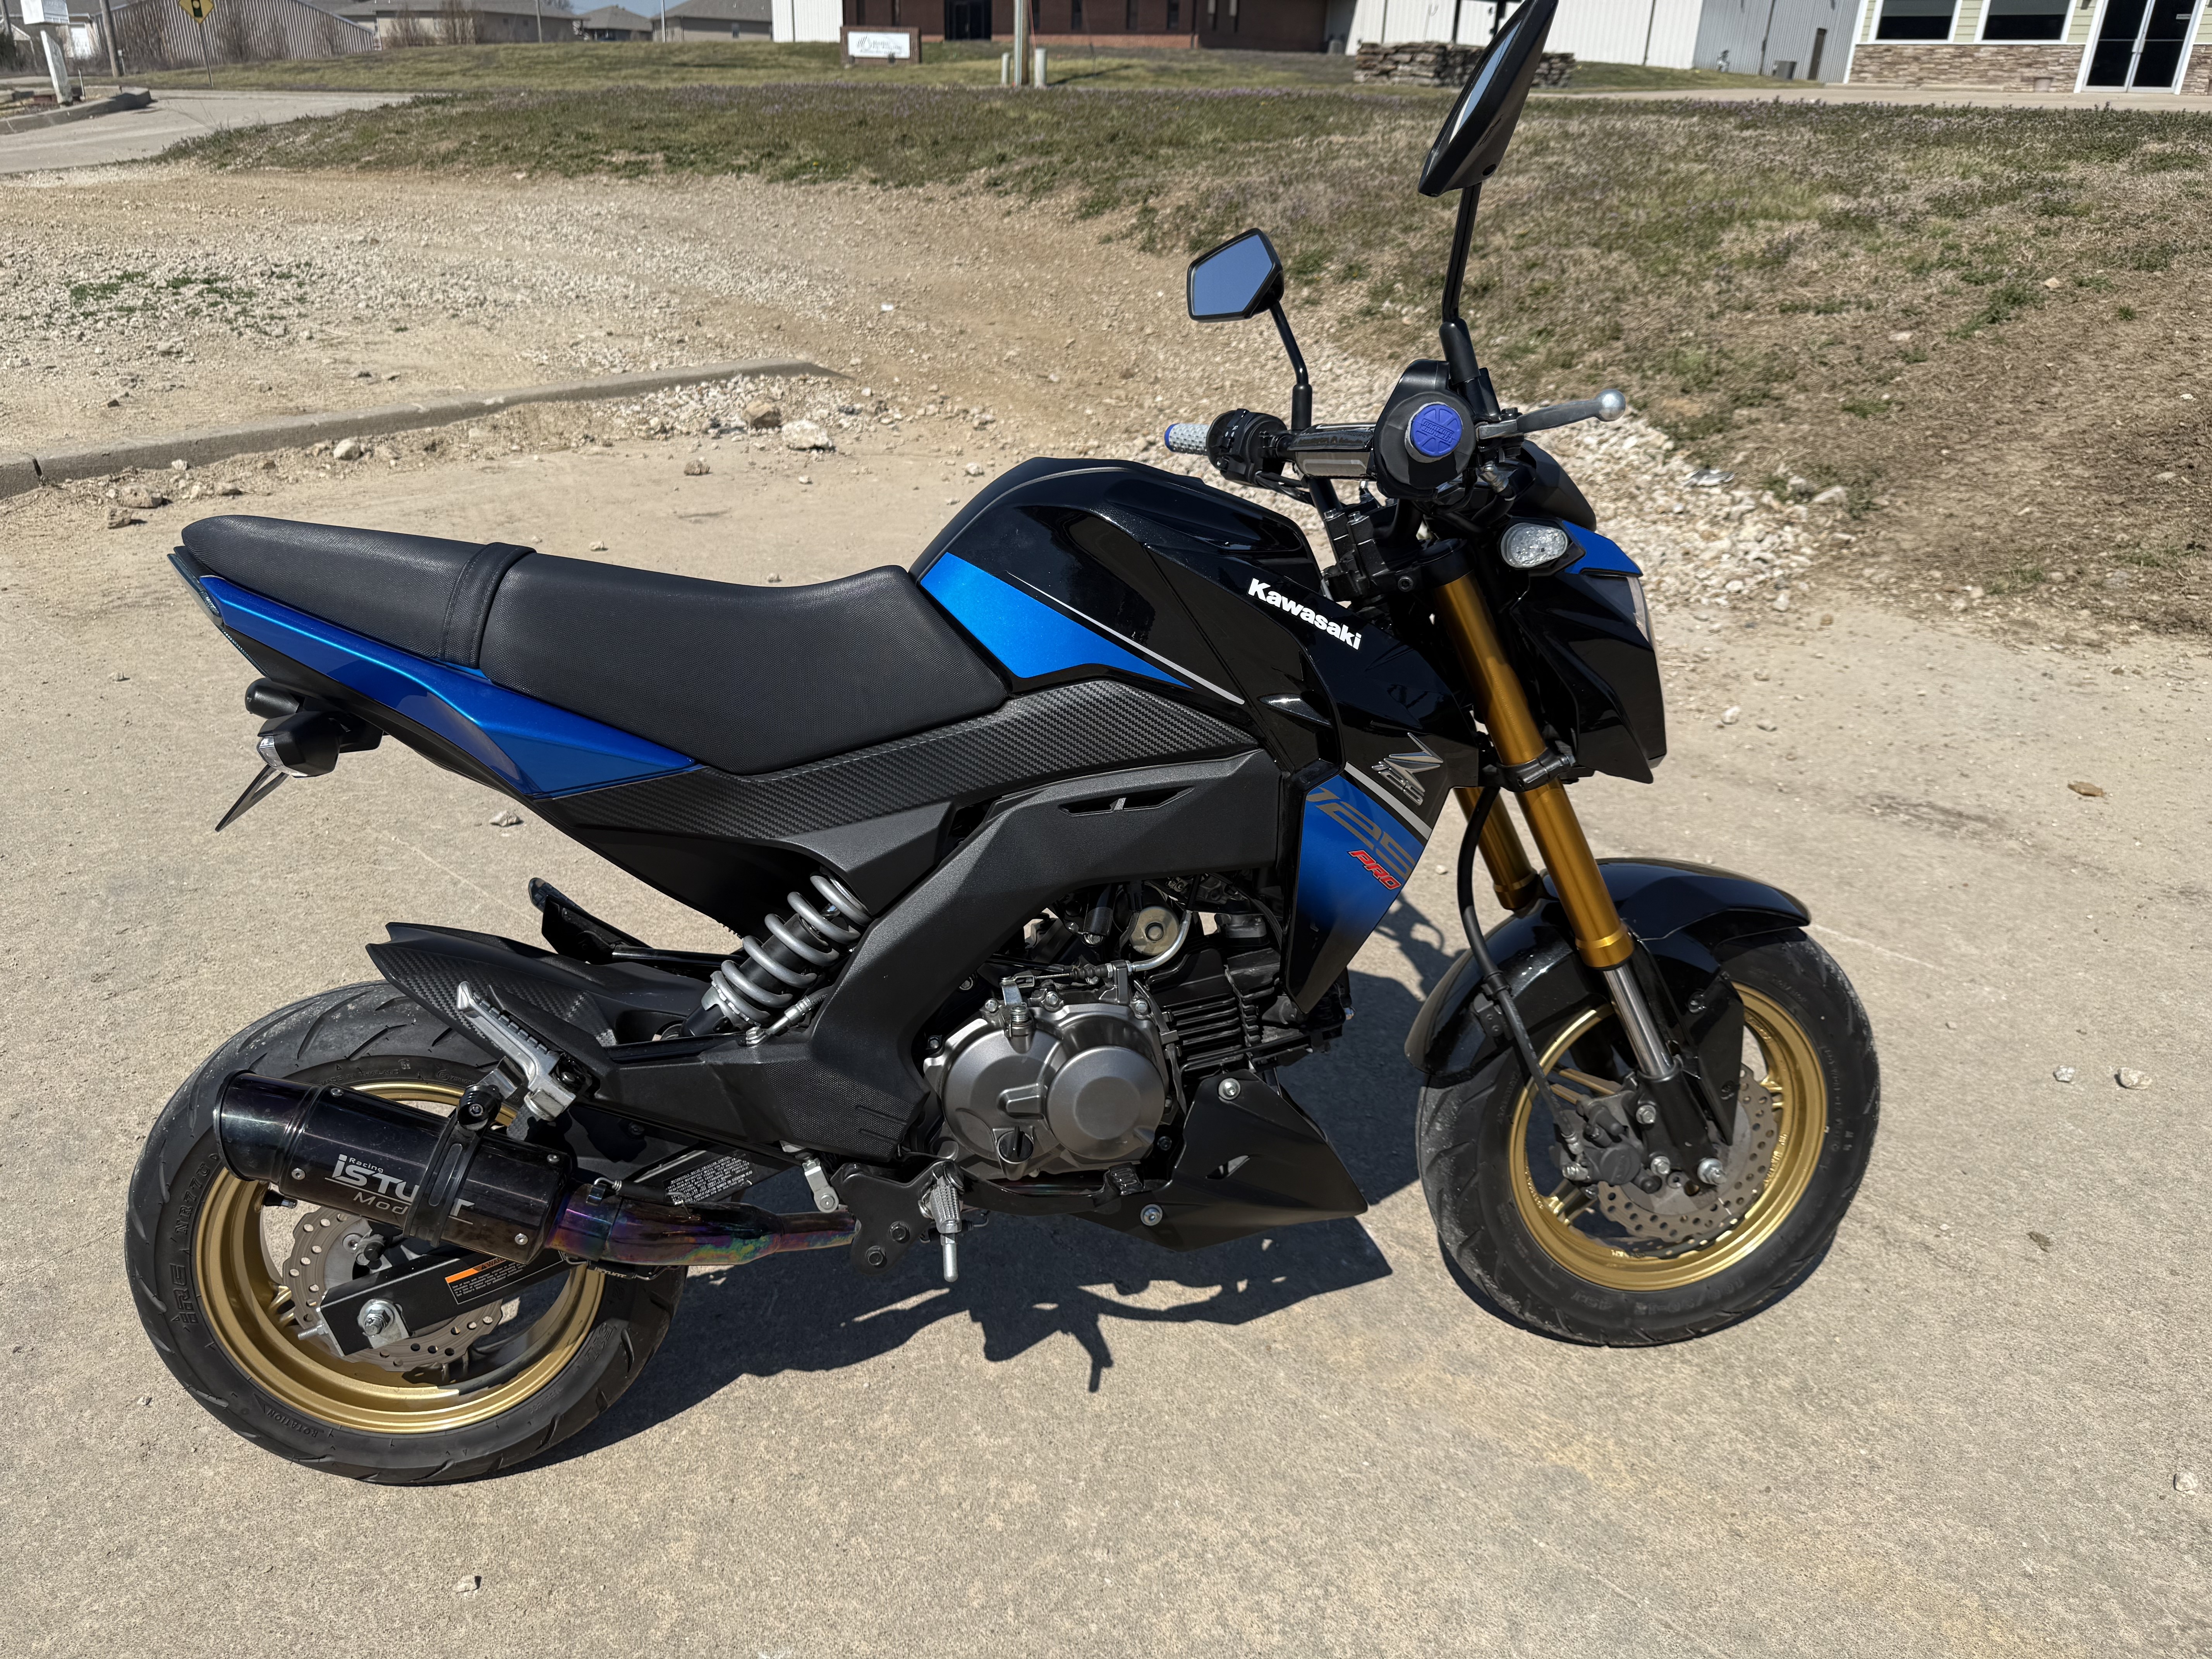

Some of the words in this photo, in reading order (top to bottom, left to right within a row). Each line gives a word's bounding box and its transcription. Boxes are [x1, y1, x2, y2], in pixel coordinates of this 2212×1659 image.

[1248, 578, 1362, 650] Kawasaki
[1307, 786, 1416, 881] 125
[1347, 849, 1403, 890] PRO
[359, 1068, 400, 1078] THAILAND
[348, 1157, 384, 1174] Racing
[174, 1161, 212, 1237] NR77U
[266, 1408, 318, 1438] ROTATION
